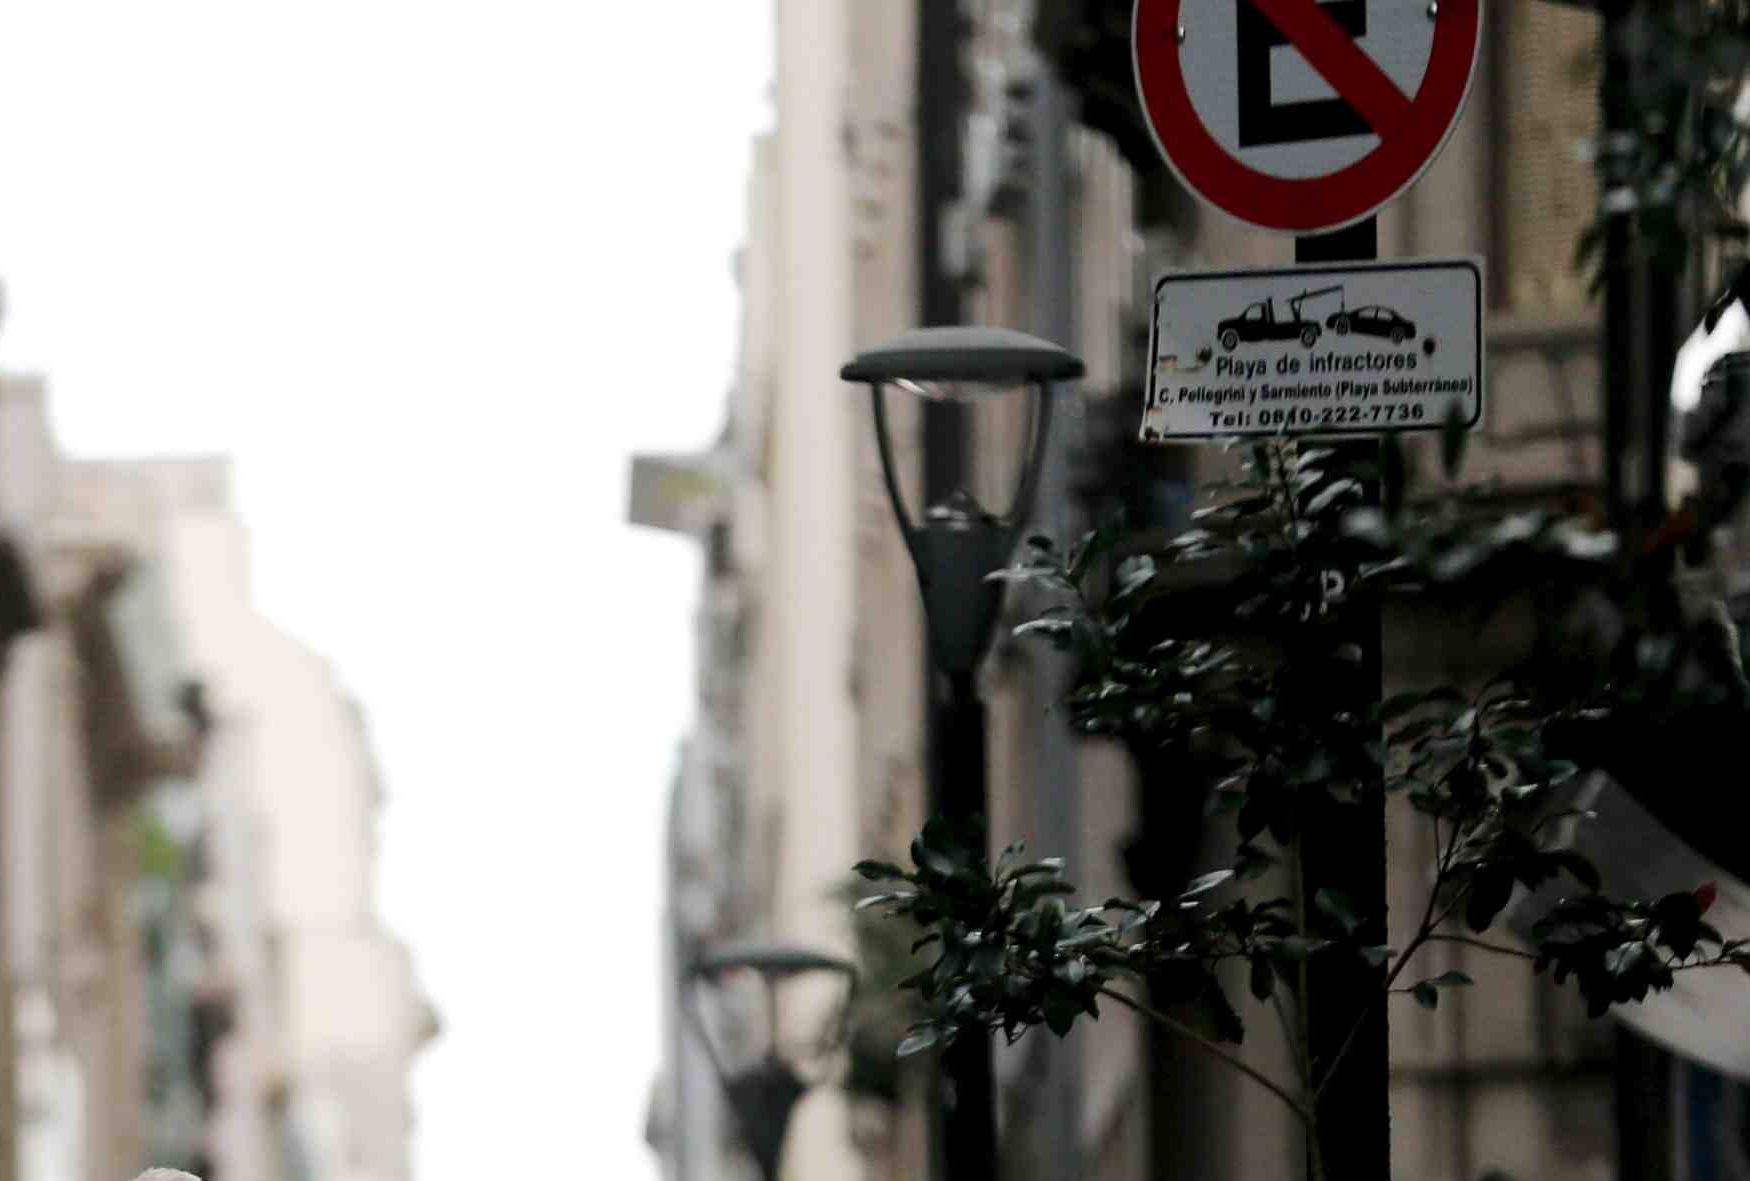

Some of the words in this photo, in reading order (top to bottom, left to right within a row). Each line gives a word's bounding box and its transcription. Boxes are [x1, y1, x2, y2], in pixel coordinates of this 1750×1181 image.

[1216, 355, 1267, 380] Playa
[1276, 353, 1301, 375] de
[1309, 350, 1418, 374] infractores
[1179, 385, 1246, 404] Pellegrini
[1249, 388, 1257, 407] y
[1261, 381, 1332, 400] Sarmiento
[1209, 409, 1251, 428] Tel:
